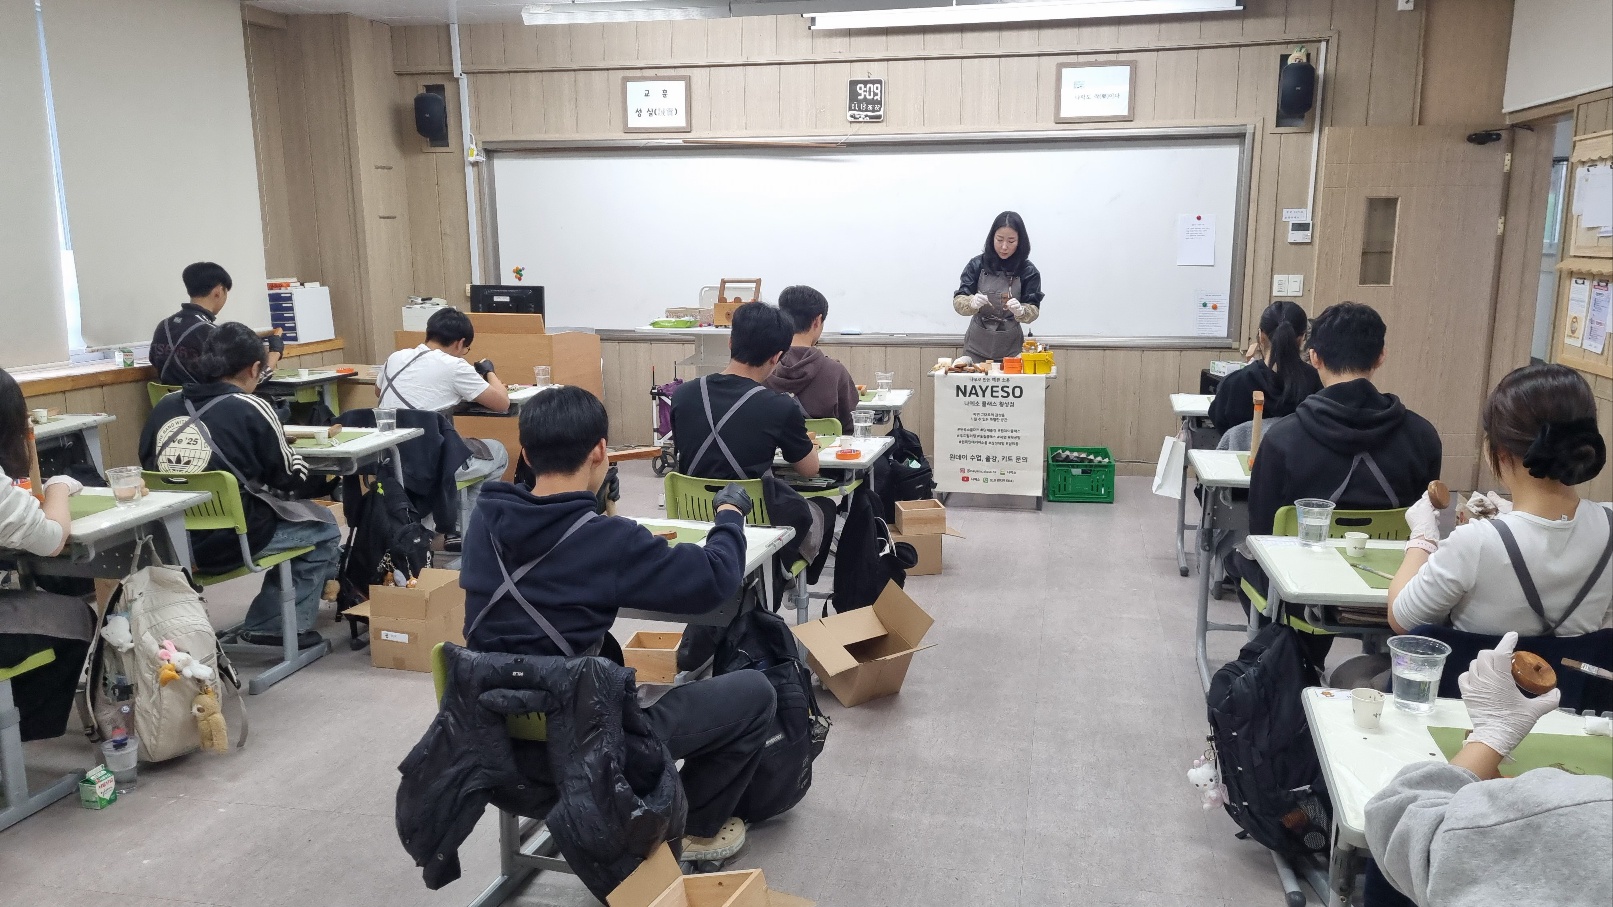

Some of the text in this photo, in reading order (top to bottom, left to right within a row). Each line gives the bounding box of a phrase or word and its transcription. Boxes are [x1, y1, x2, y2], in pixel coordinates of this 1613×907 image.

[856, 83, 881, 100] 9:09
[955, 384, 1024, 399] NAYESO
[949, 453, 968, 462] 원데이
[969, 454, 984, 462] 수업,
